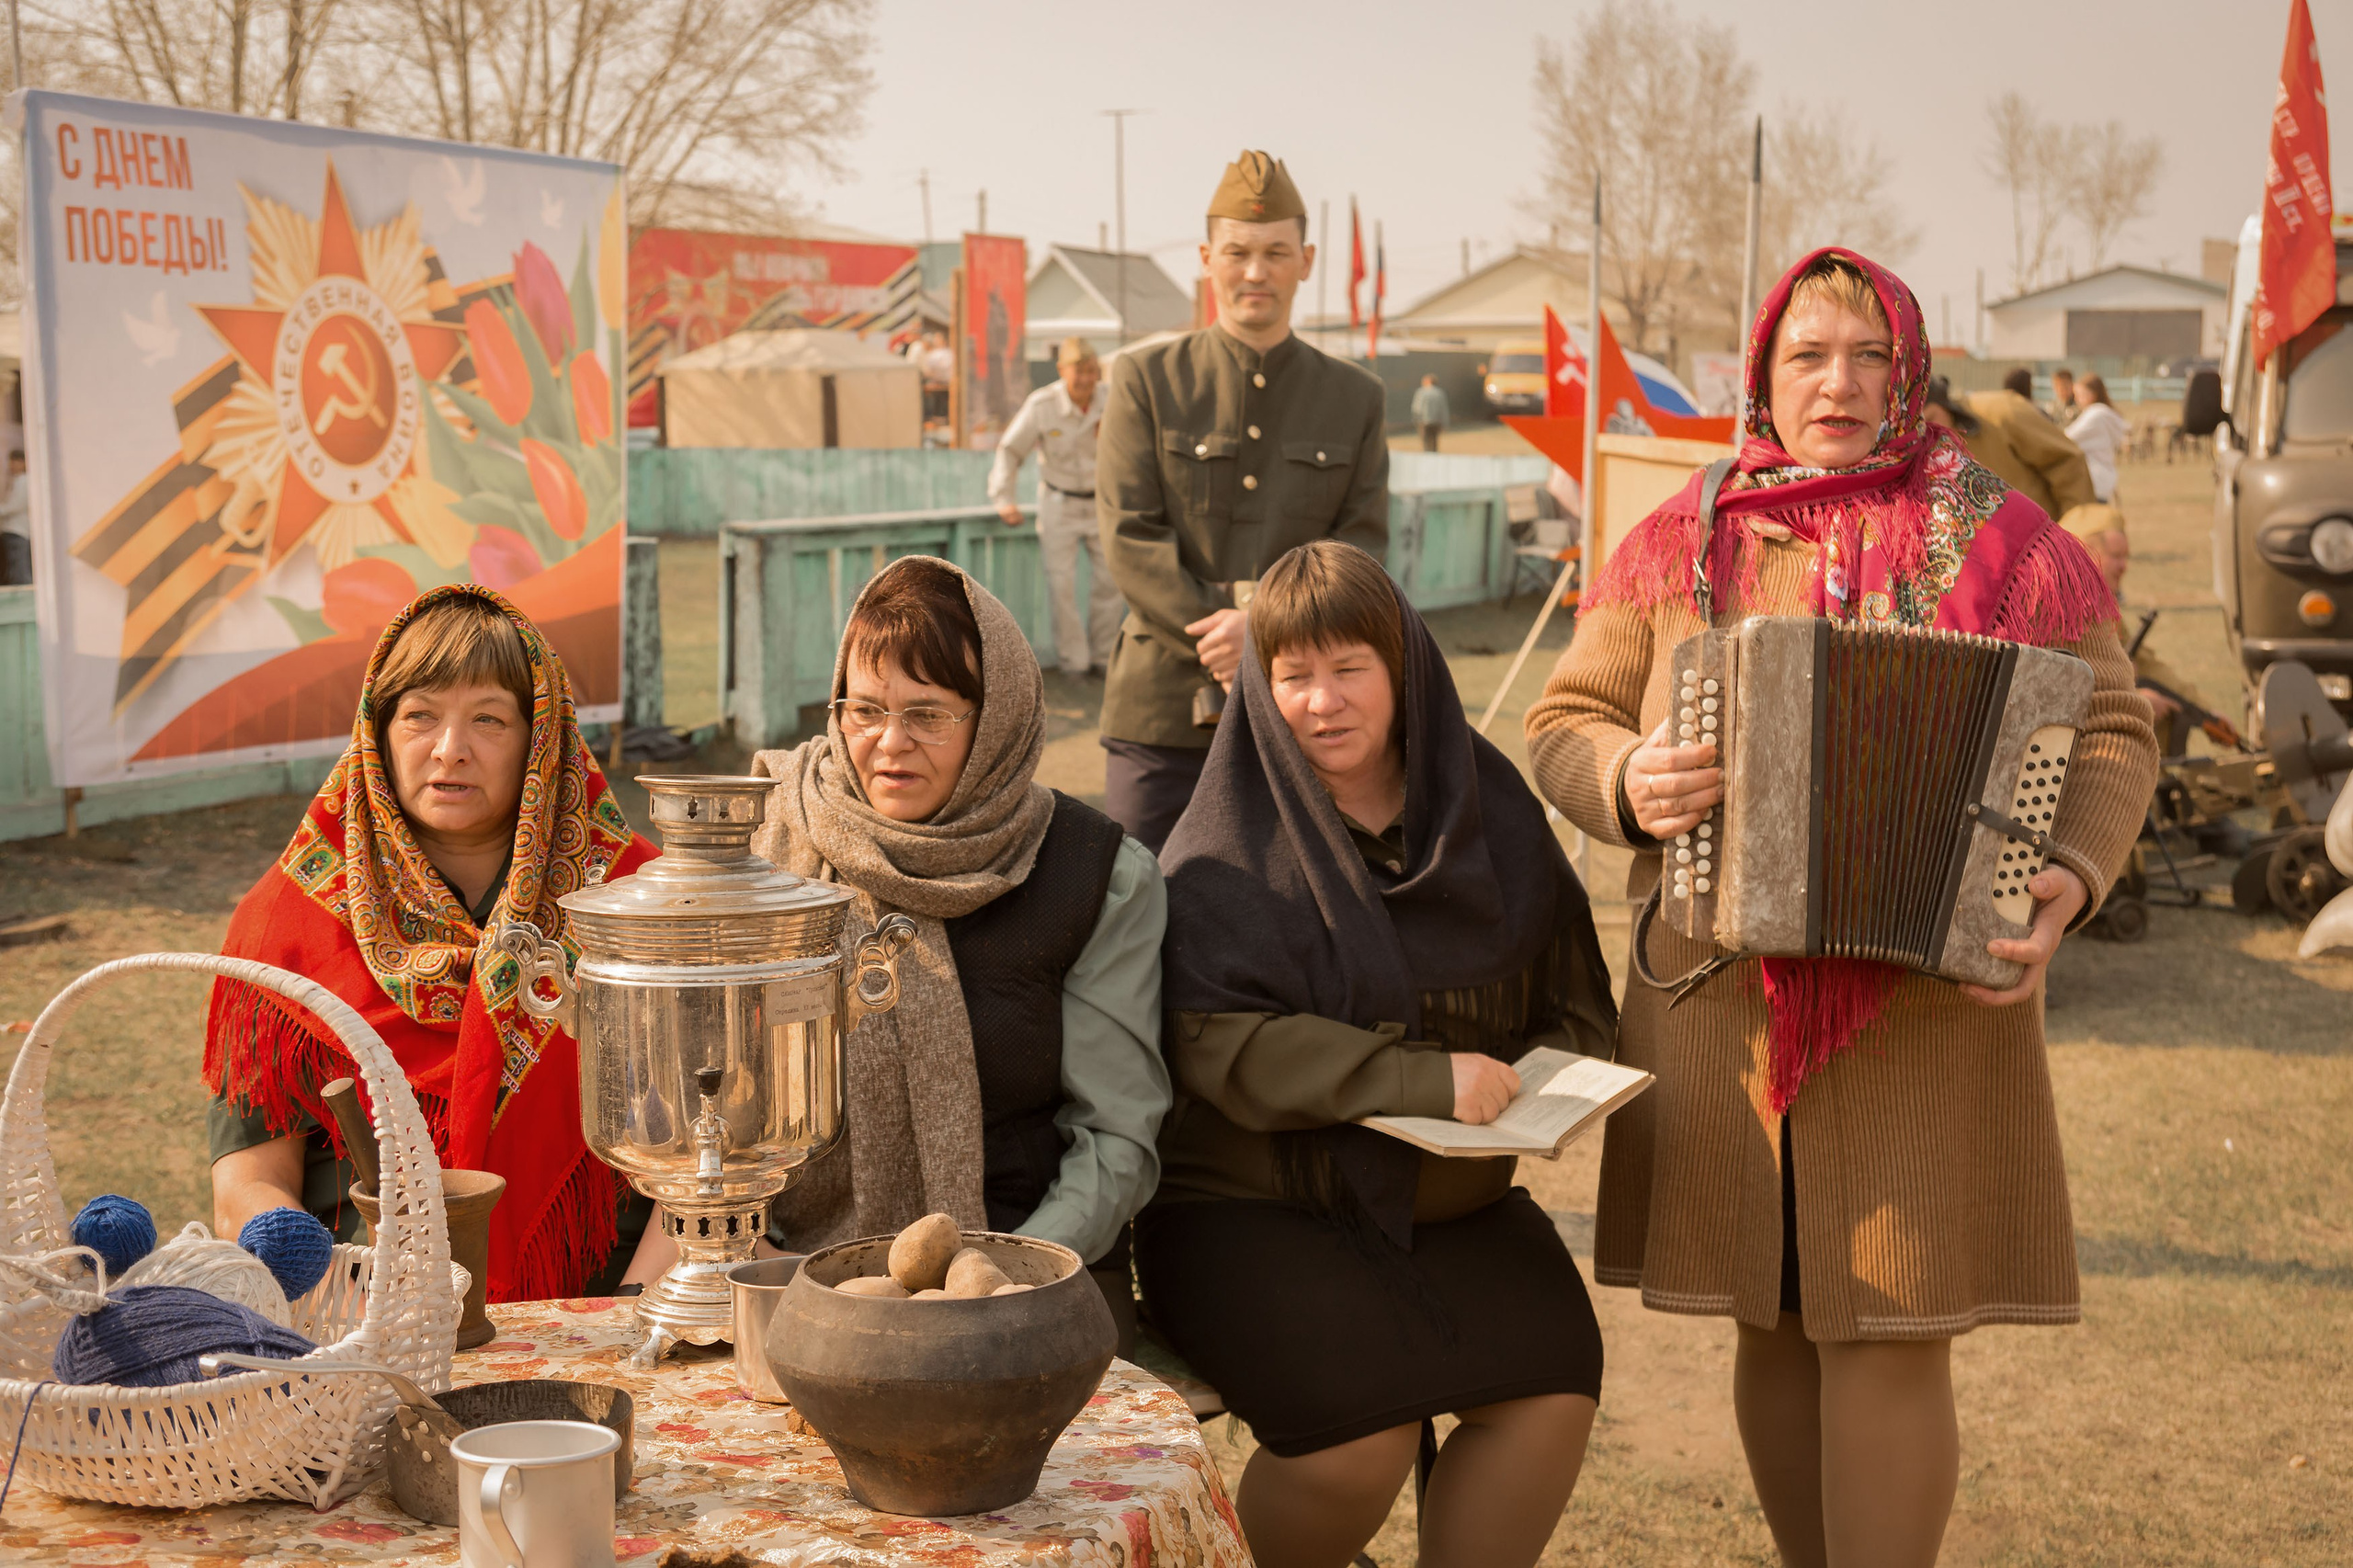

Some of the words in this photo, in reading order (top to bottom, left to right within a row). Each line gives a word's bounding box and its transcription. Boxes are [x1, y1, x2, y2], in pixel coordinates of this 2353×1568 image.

[57, 123, 81, 180] С
[93, 127, 194, 191] ДНЕМ
[65, 205, 229, 277] ПОБЕДЫ!
[280, 285, 402, 479] ОТЕЧЕСТВЕННАЯ
